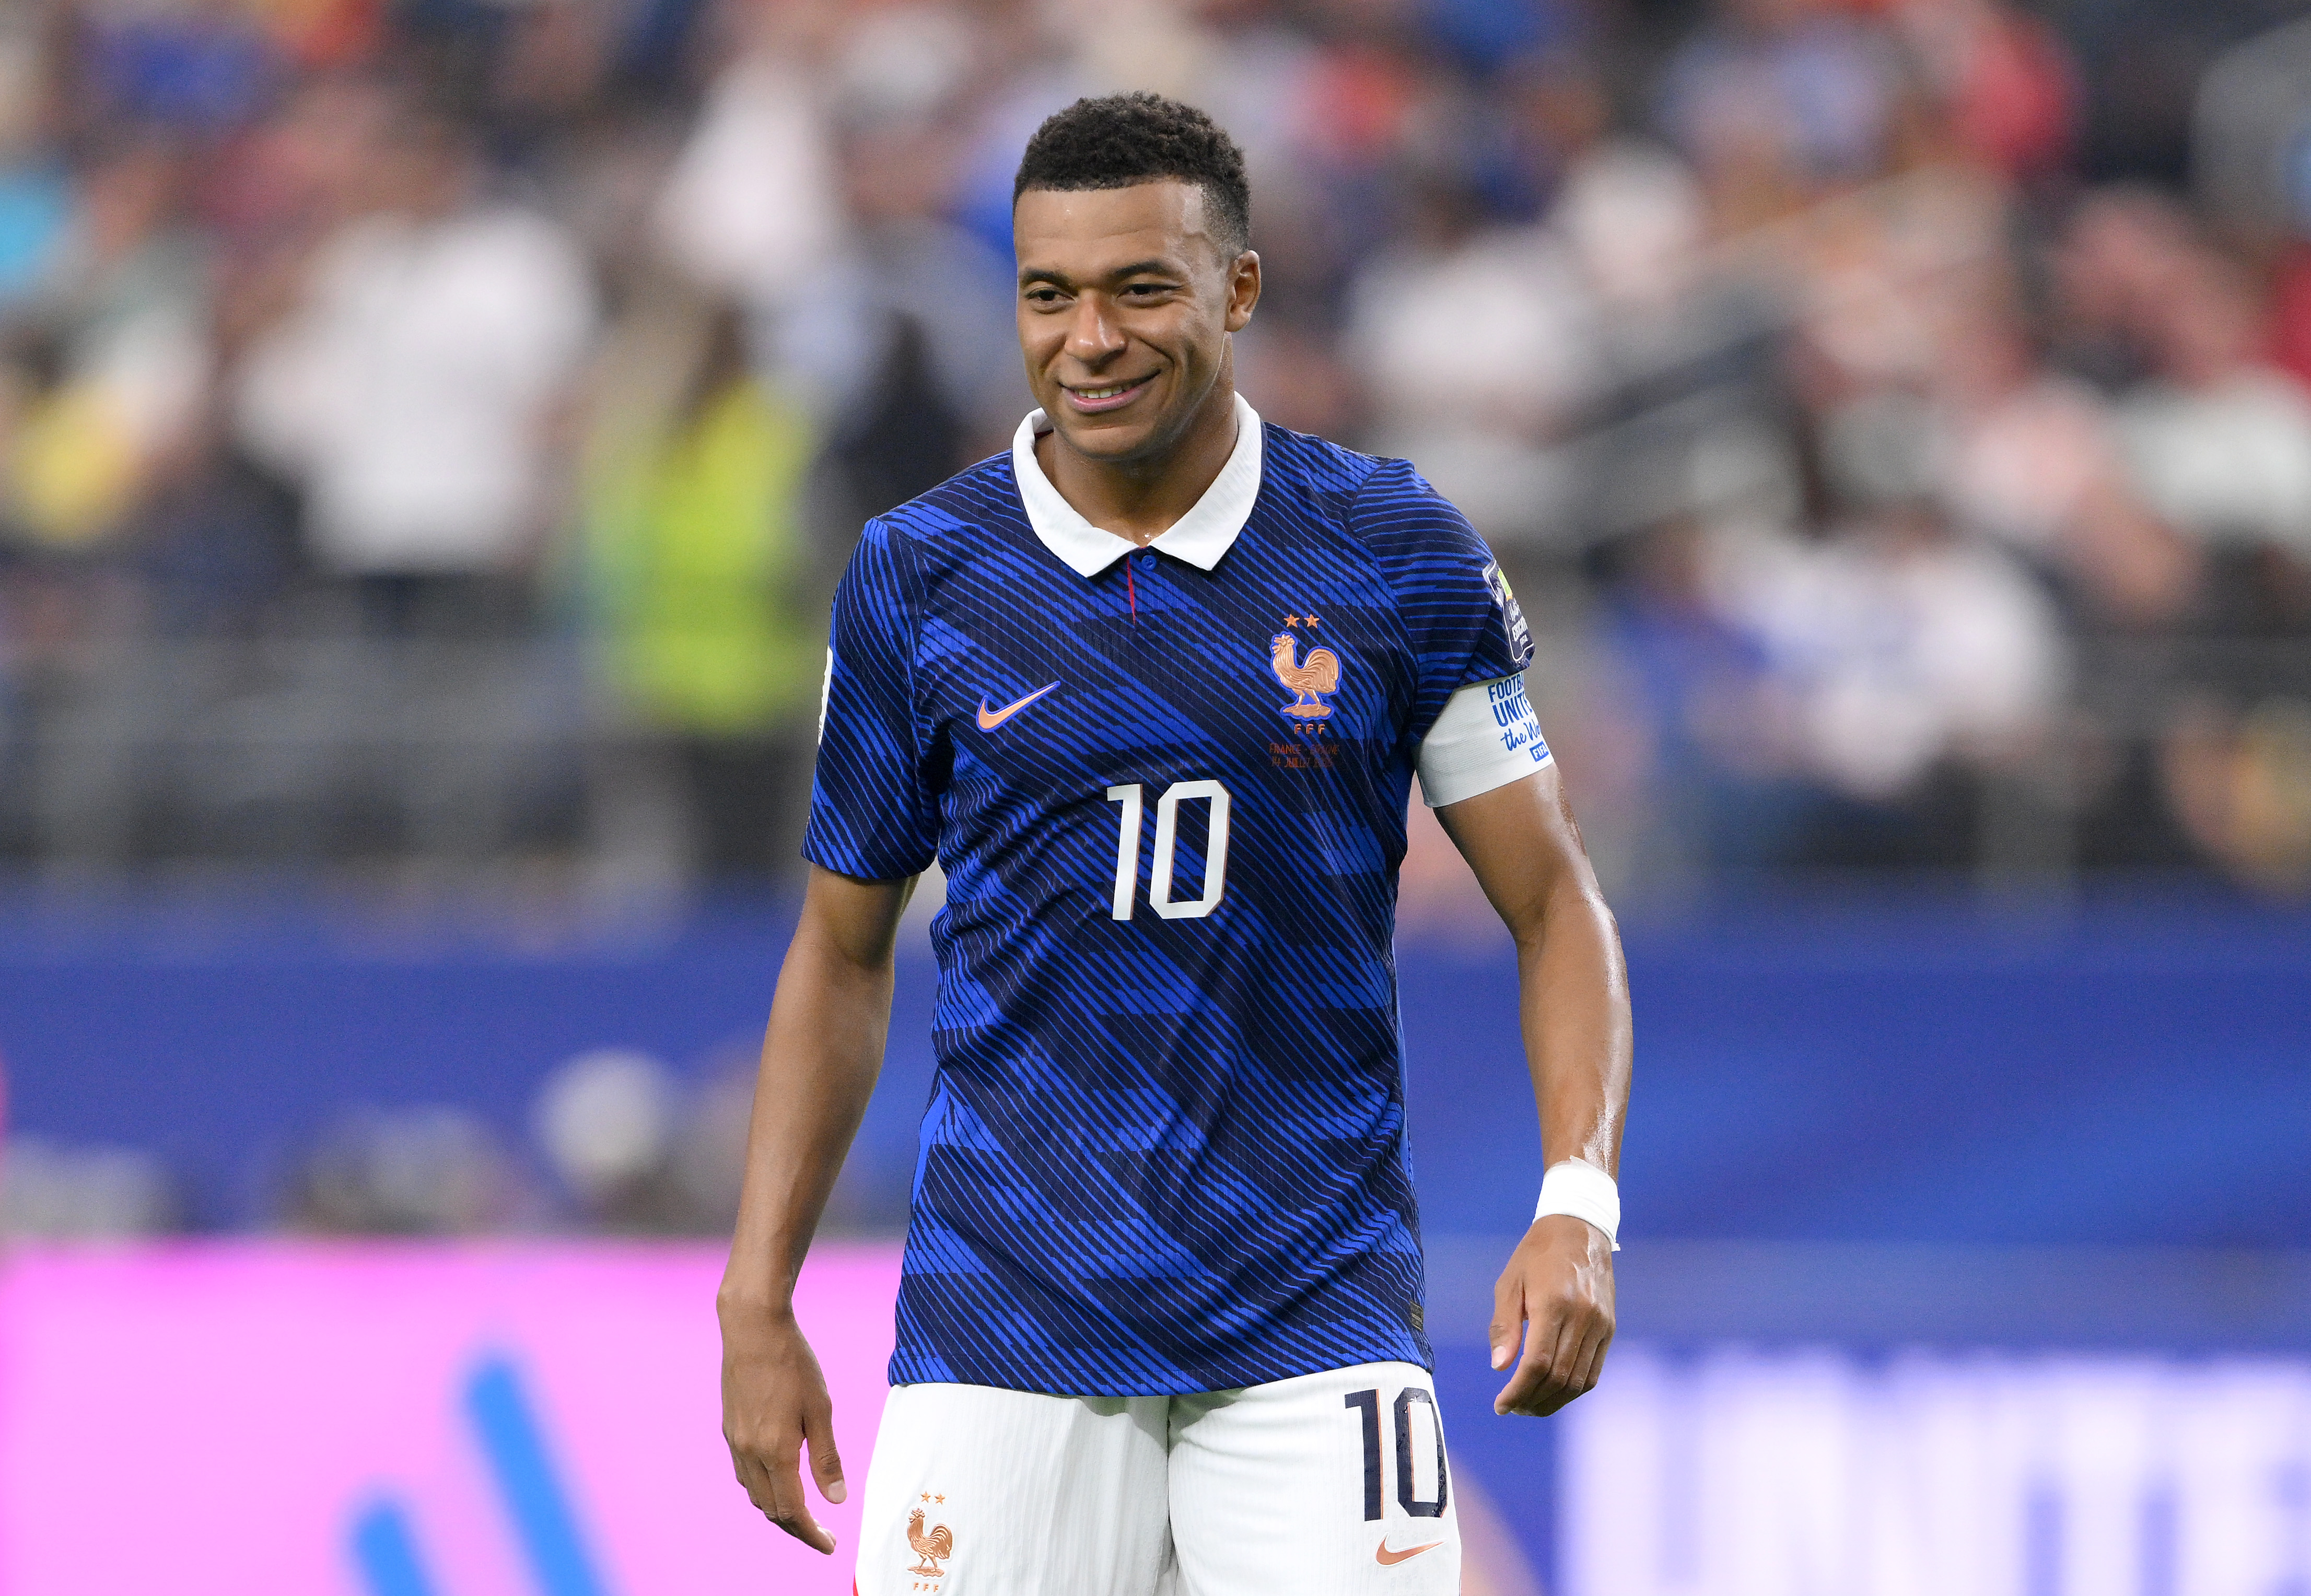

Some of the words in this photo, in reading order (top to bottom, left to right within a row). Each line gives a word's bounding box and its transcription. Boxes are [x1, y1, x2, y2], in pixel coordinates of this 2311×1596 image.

[1269, 743, 1302, 755] FRANCE
[1500, 728, 1527, 752] the
[1532, 745, 1549, 759] FIFA
[1106, 779, 1232, 921] 10
[1344, 1386, 1448, 1522] 10
